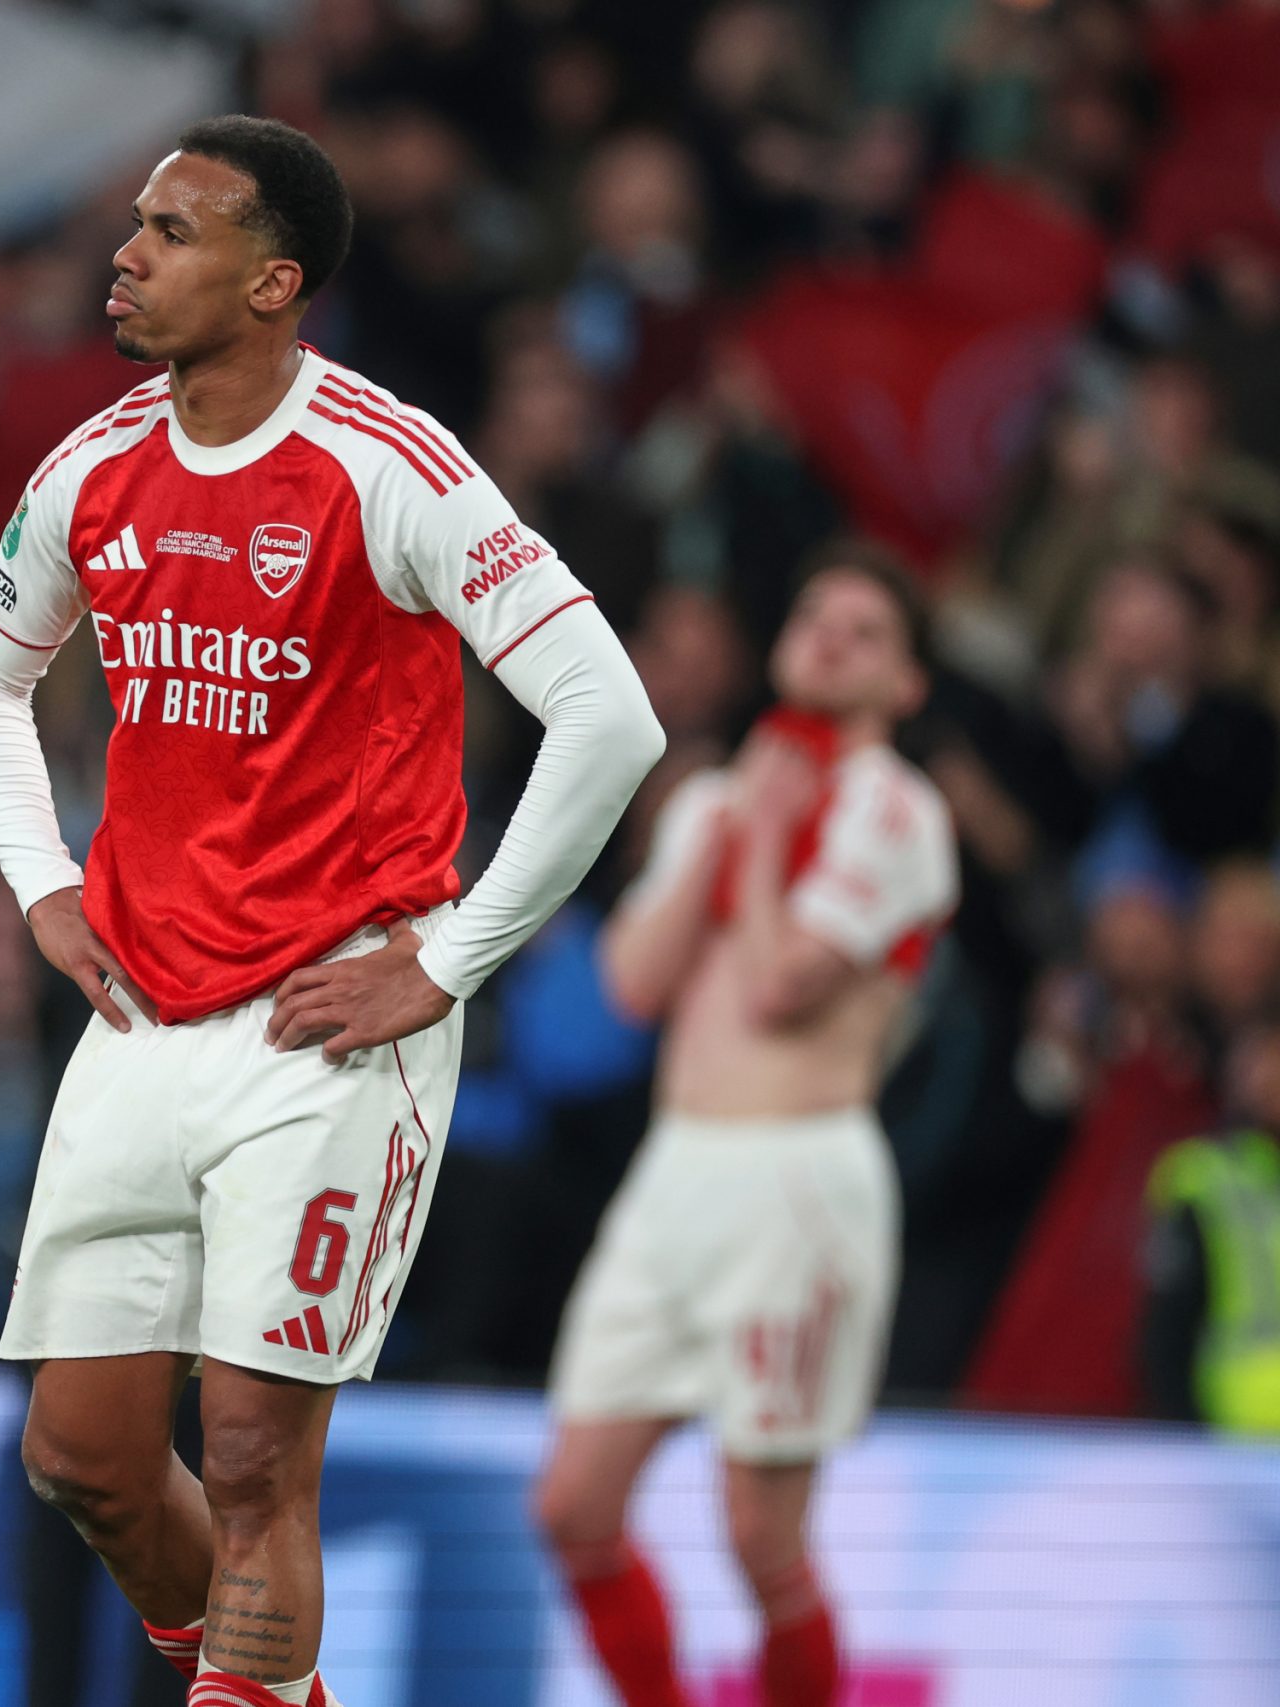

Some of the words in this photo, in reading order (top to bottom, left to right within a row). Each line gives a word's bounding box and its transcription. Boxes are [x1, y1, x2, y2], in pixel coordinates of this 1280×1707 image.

[193, 532, 209, 541] CUP
[223, 546, 239, 556] CITY
[260, 534, 302, 551] Arsenal
[466, 522, 523, 565] VISIT
[461, 540, 551, 605] RWANDA
[91, 608, 312, 682] Emirates
[161, 678, 269, 735] BETTER
[288, 1187, 359, 1298] 6
